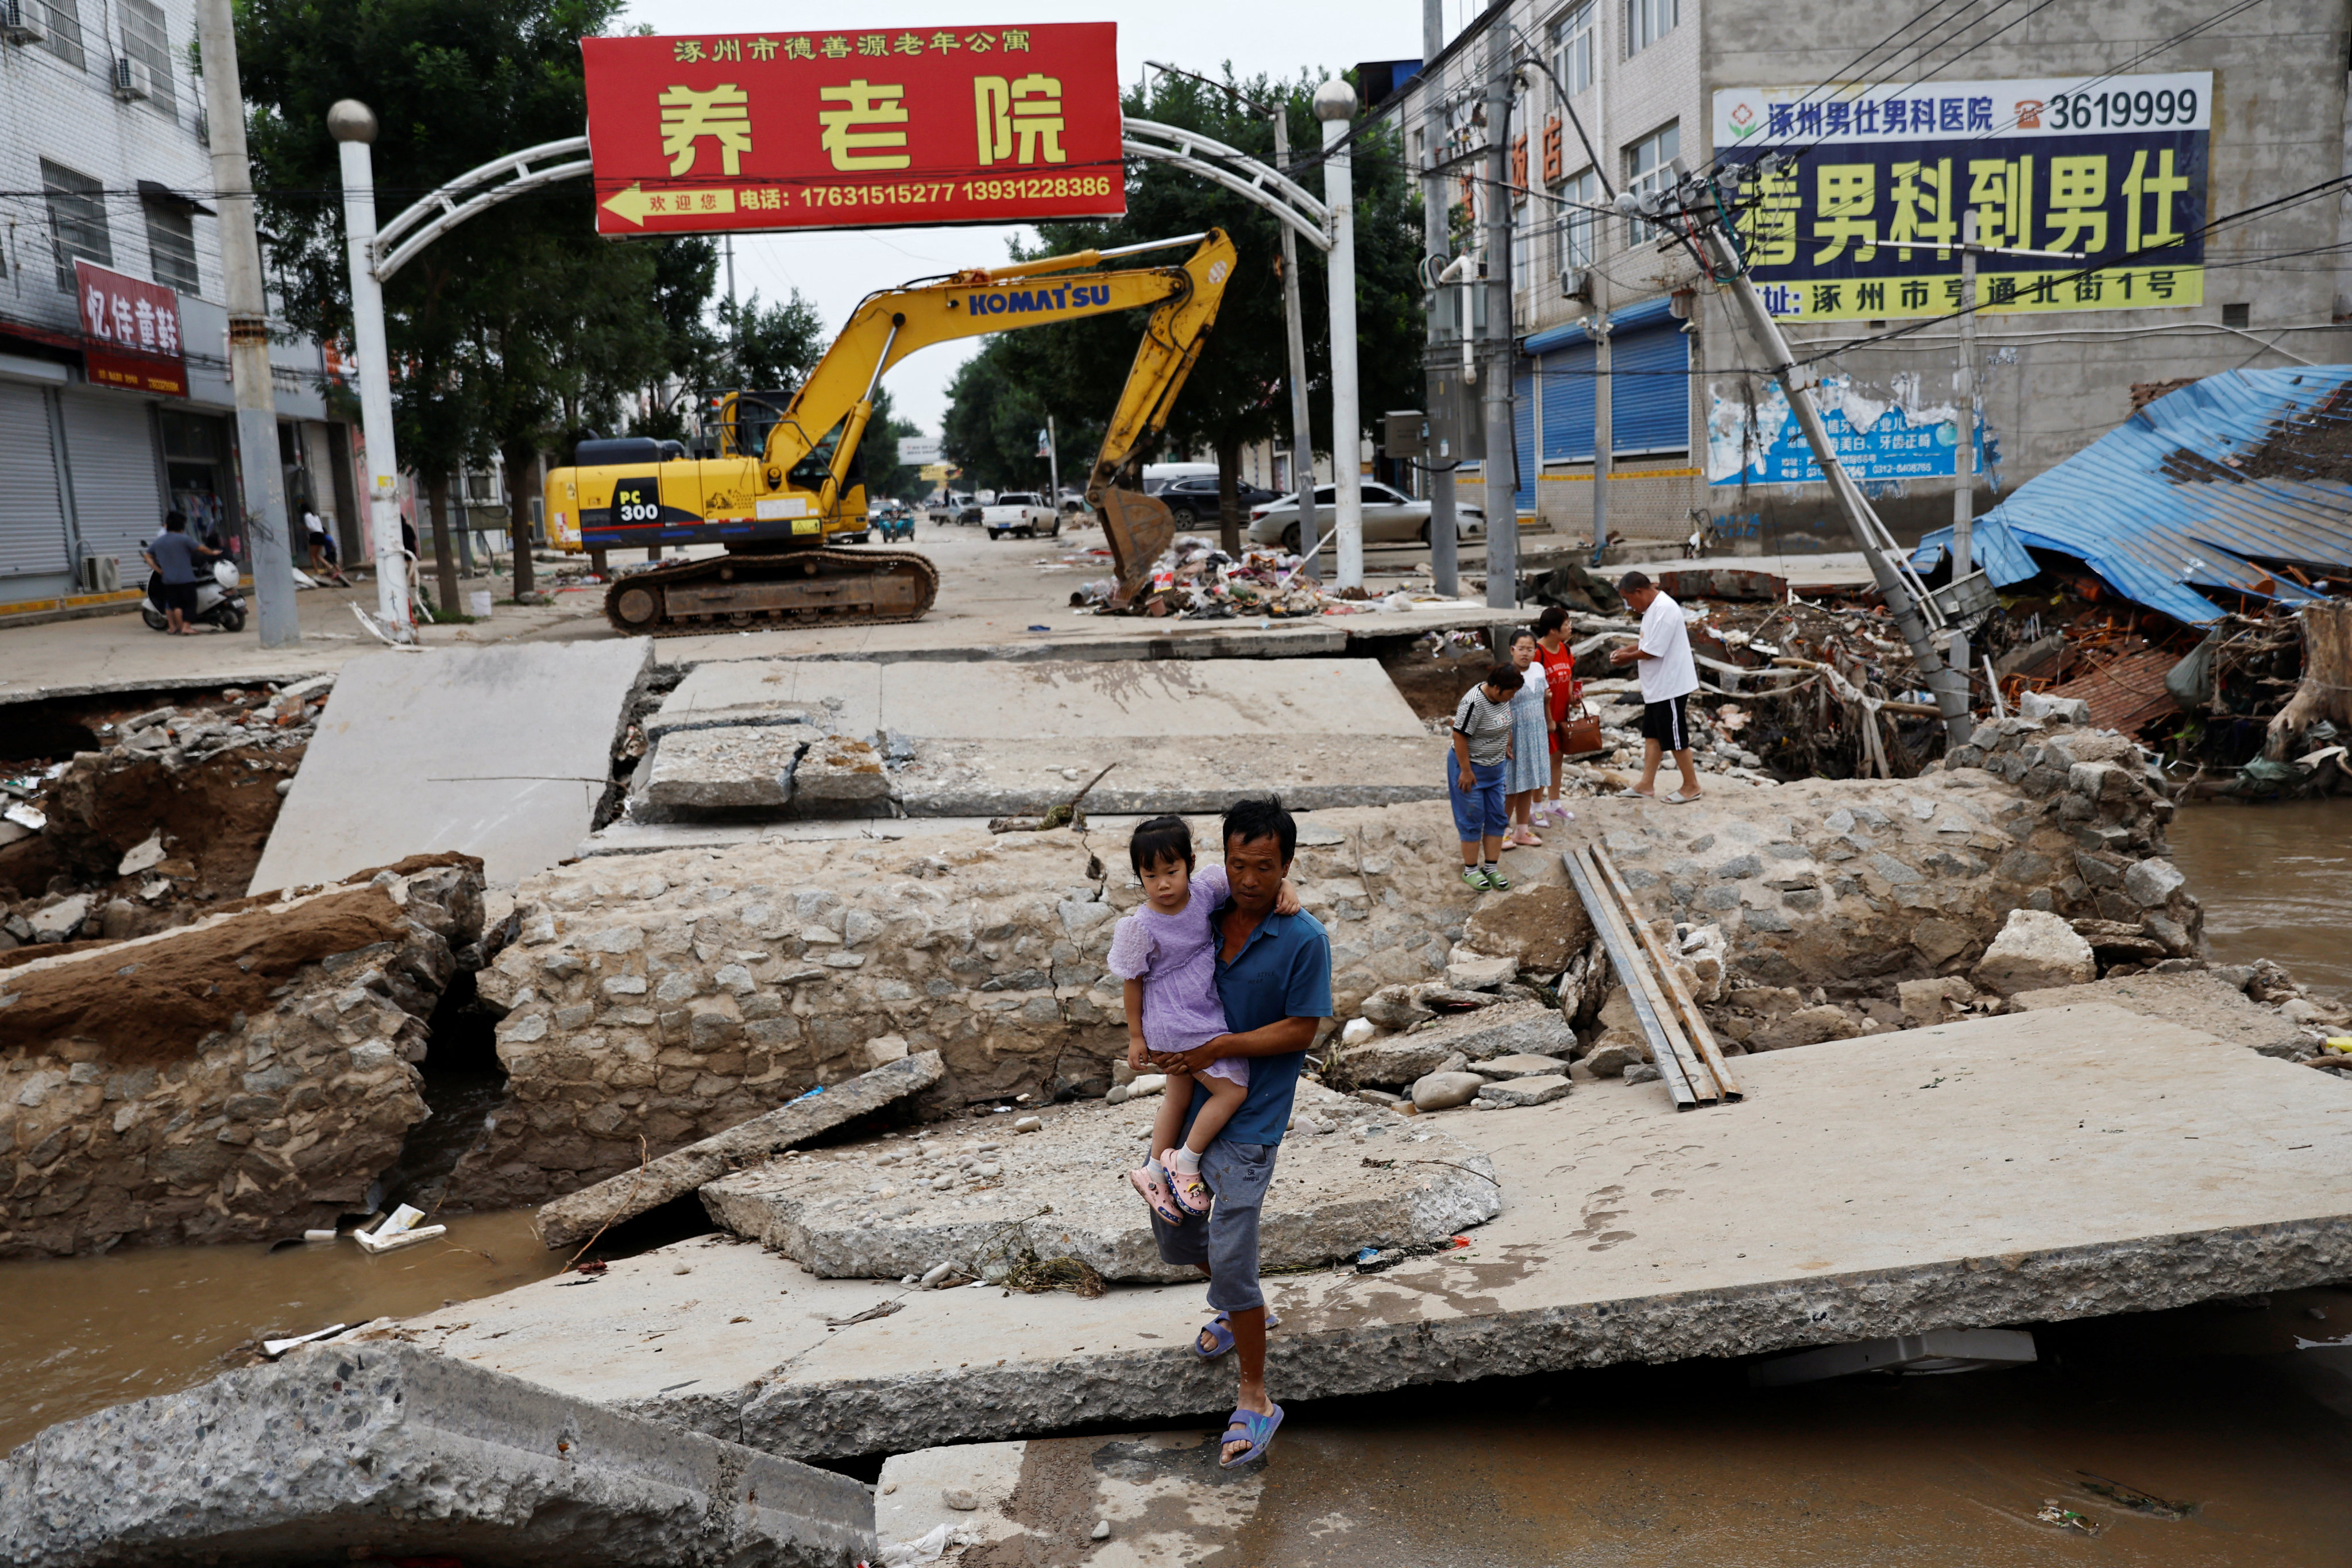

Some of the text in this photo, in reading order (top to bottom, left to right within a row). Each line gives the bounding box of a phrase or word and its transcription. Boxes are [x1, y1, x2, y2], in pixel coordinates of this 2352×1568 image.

[673, 29, 1030, 64] 涿州市德善源老年公寓
[658, 73, 1068, 178] 养老院
[1768, 88, 2197, 138] 涿州男仕男科医院 3619999
[650, 193, 717, 213] 欢迎您
[739, 176, 1111, 210] 电话: 17631515277 13931228386
[969, 283, 1110, 315] KOMATSU
[87, 283, 179, 357] 忆佳童鞋
[620, 491, 640, 505] PC
[620, 503, 658, 522] 300
